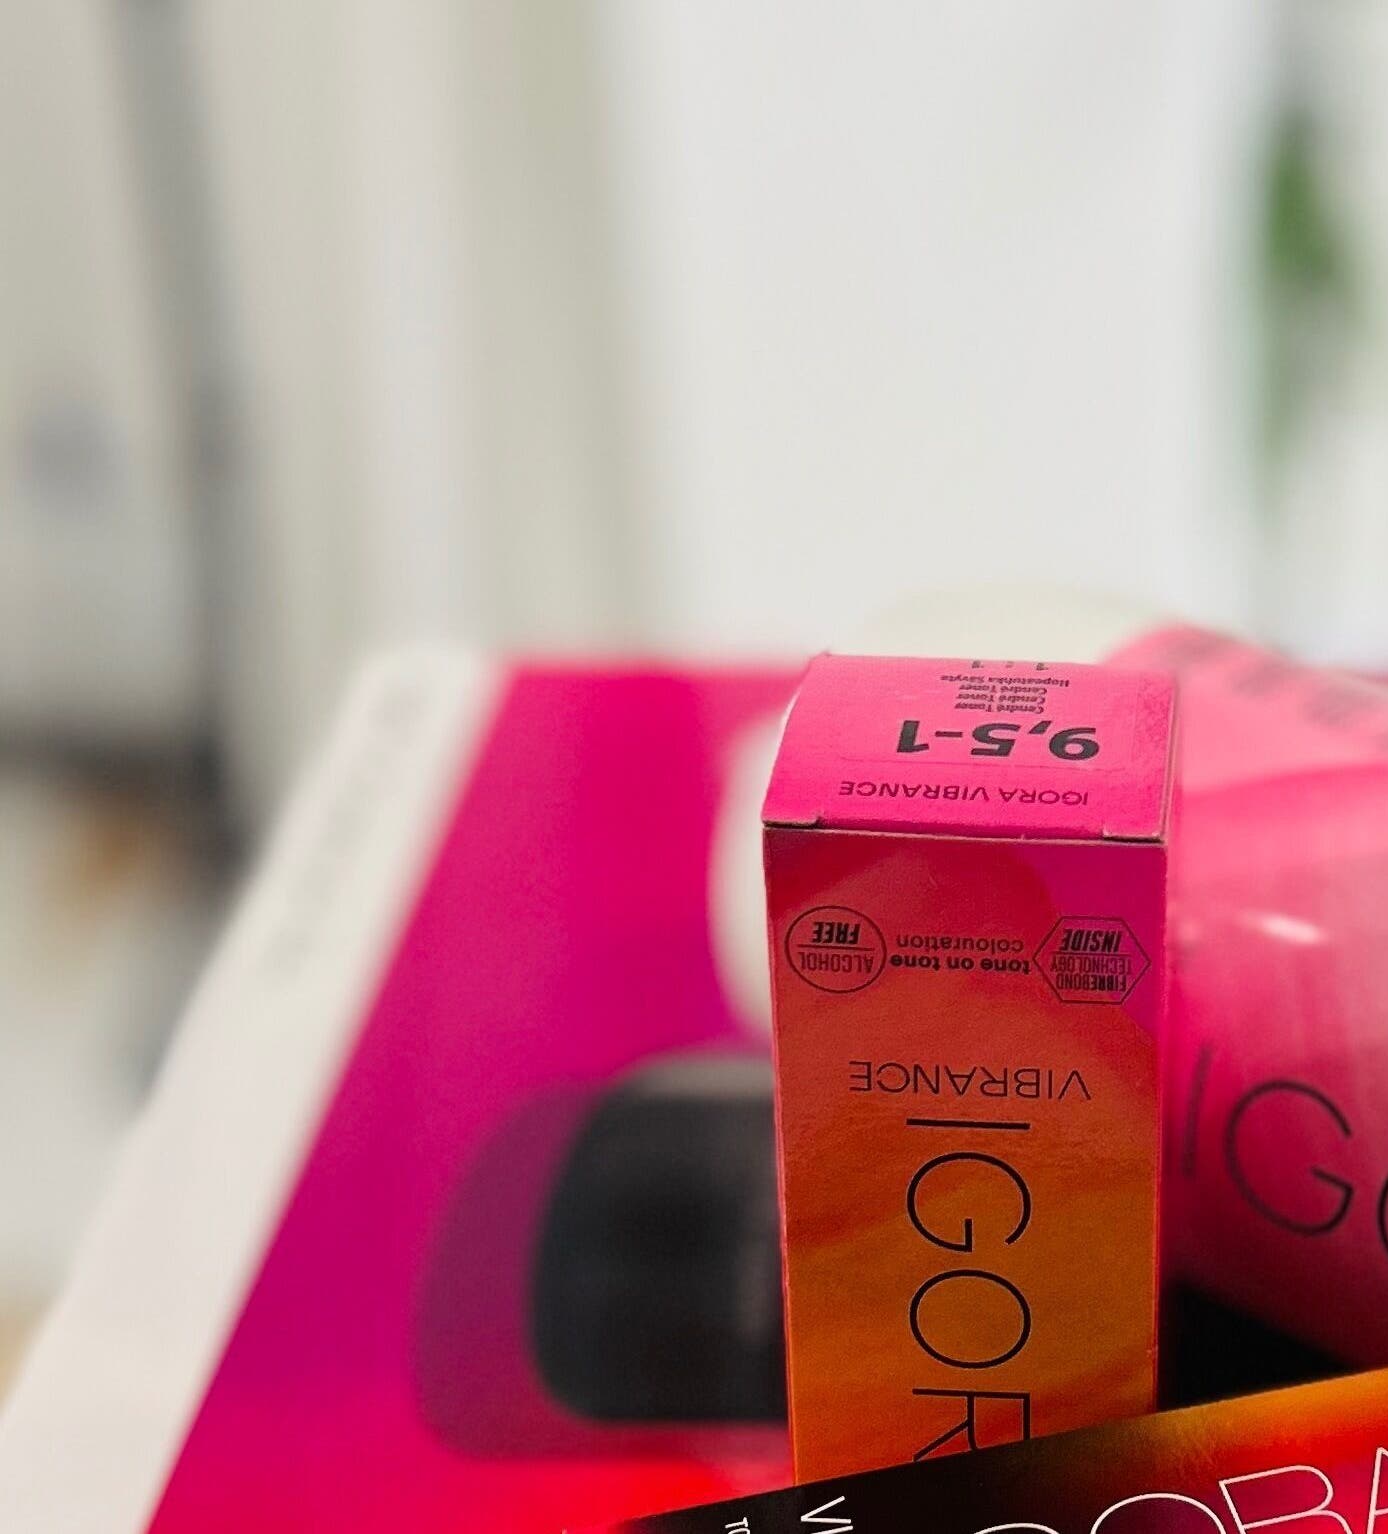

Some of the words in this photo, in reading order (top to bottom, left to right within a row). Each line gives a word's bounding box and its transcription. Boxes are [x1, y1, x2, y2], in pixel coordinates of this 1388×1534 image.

[896, 719, 1100, 760] 9,5-1
[839, 781, 989, 801] VIBRANCE
[999, 787, 1089, 806] IGORA
[811, 921, 860, 944] FREE
[1058, 928, 1121, 952] INSIDE
[896, 936, 1025, 953] colouration
[797, 950, 875, 973] ALCOHOL
[889, 955, 940, 971] tone
[948, 956, 975, 971] on
[980, 956, 1031, 975] tone
[1049, 953, 1132, 974] TECHNOLOGY
[1055, 972, 1127, 993] FIBREBOND
[849, 1060, 1092, 1100] VIBRANCE
